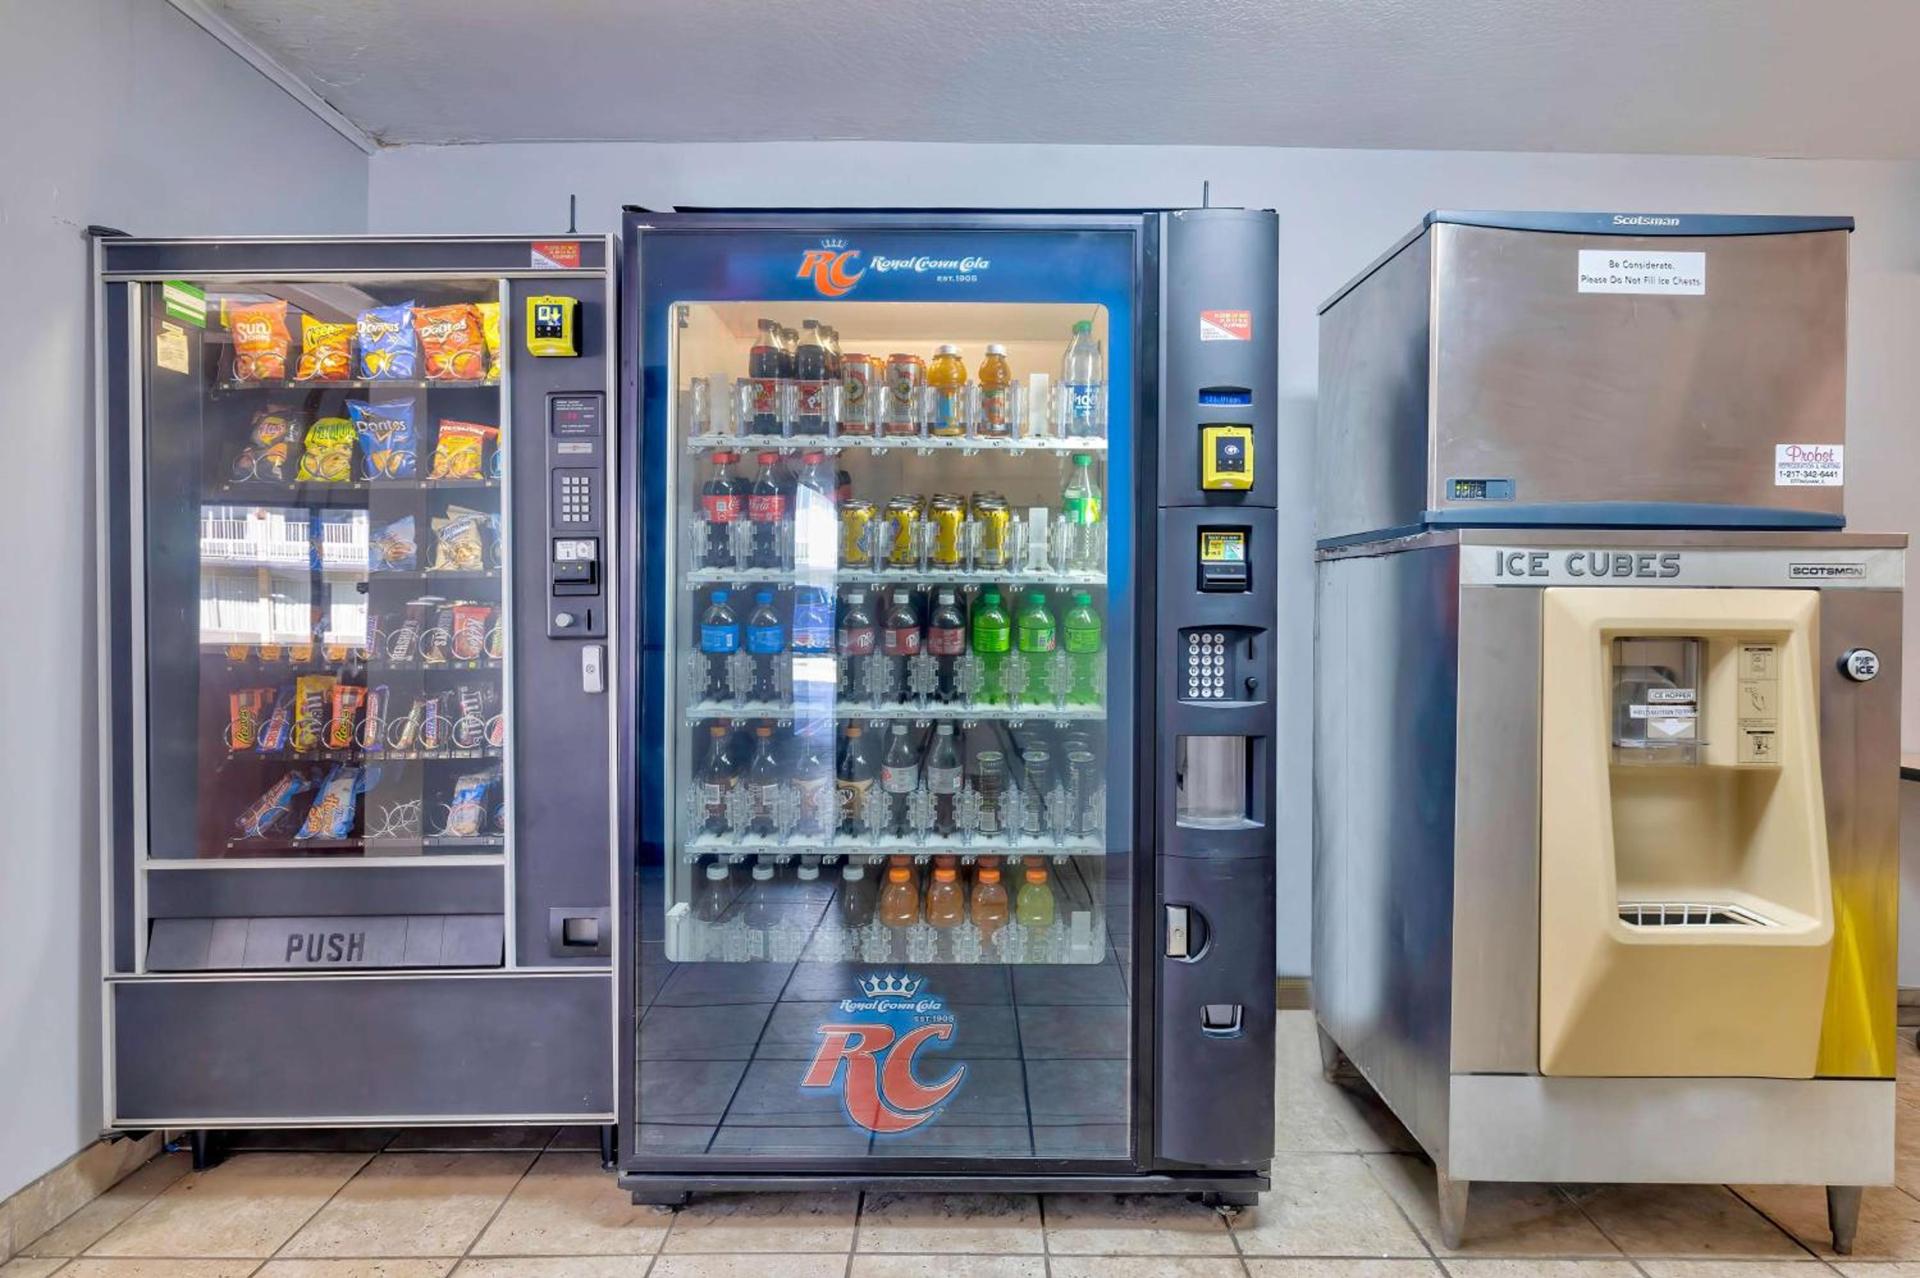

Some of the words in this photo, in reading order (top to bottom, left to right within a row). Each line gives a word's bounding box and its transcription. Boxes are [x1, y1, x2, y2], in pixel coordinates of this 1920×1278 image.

[1613, 215, 1680, 226] Scotsman
[869, 256, 914, 272] Royal
[914, 257, 958, 272] Crown
[959, 256, 990, 273] Cola
[1608, 260, 1619, 269] Be
[796, 250, 866, 297] RC
[1581, 274, 1607, 284] Please
[1610, 275, 1622, 284] Do
[1625, 275, 1641, 285] Not
[1644, 276, 1656, 285] Fill
[1658, 276, 1670, 286] Ice
[421, 318, 468, 338] Doritos
[356, 419, 408, 433] Doritos
[1495, 551, 1550, 578] ICE
[1565, 552, 1680, 578] CUBES
[1792, 566, 1863, 575] SCOTSMAN
[1855, 665, 1875, 675] ICE
[285, 932, 366, 963] PUSH
[839, 999, 877, 1012] Royal
[877, 1000, 915, 1012] Crown
[915, 1000, 942, 1013] Cola
[801, 1024, 966, 1133] RC
